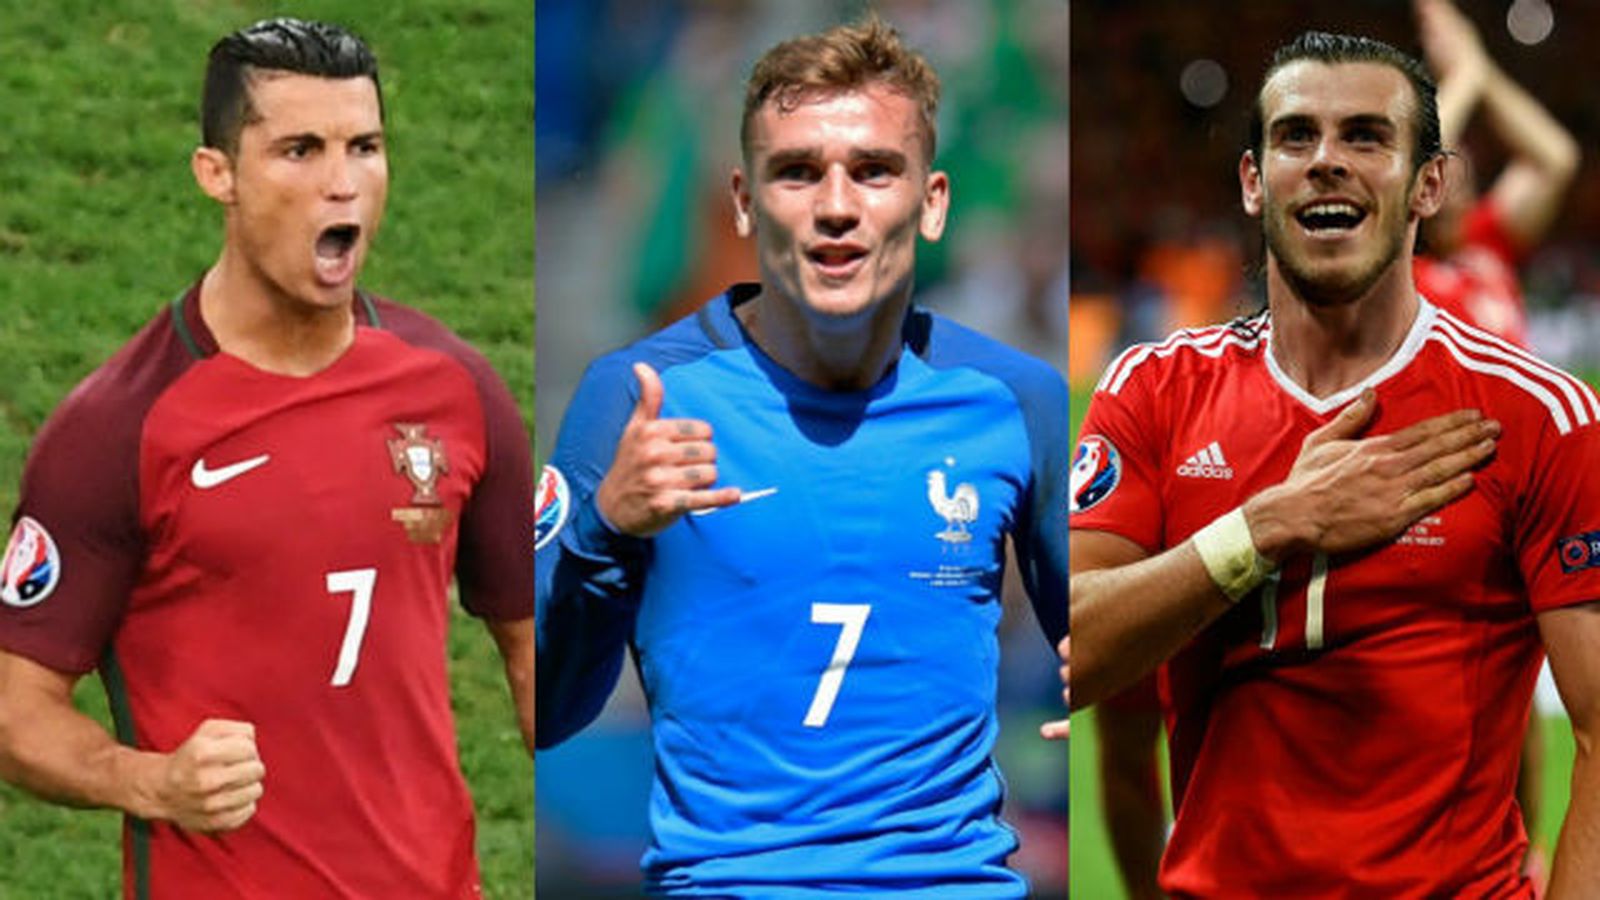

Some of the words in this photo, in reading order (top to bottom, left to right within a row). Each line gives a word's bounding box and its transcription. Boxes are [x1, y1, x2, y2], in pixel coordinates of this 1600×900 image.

[1176, 462, 1233, 479] adidas
[326, 567, 377, 687] 7
[801, 602, 871, 727] 7
